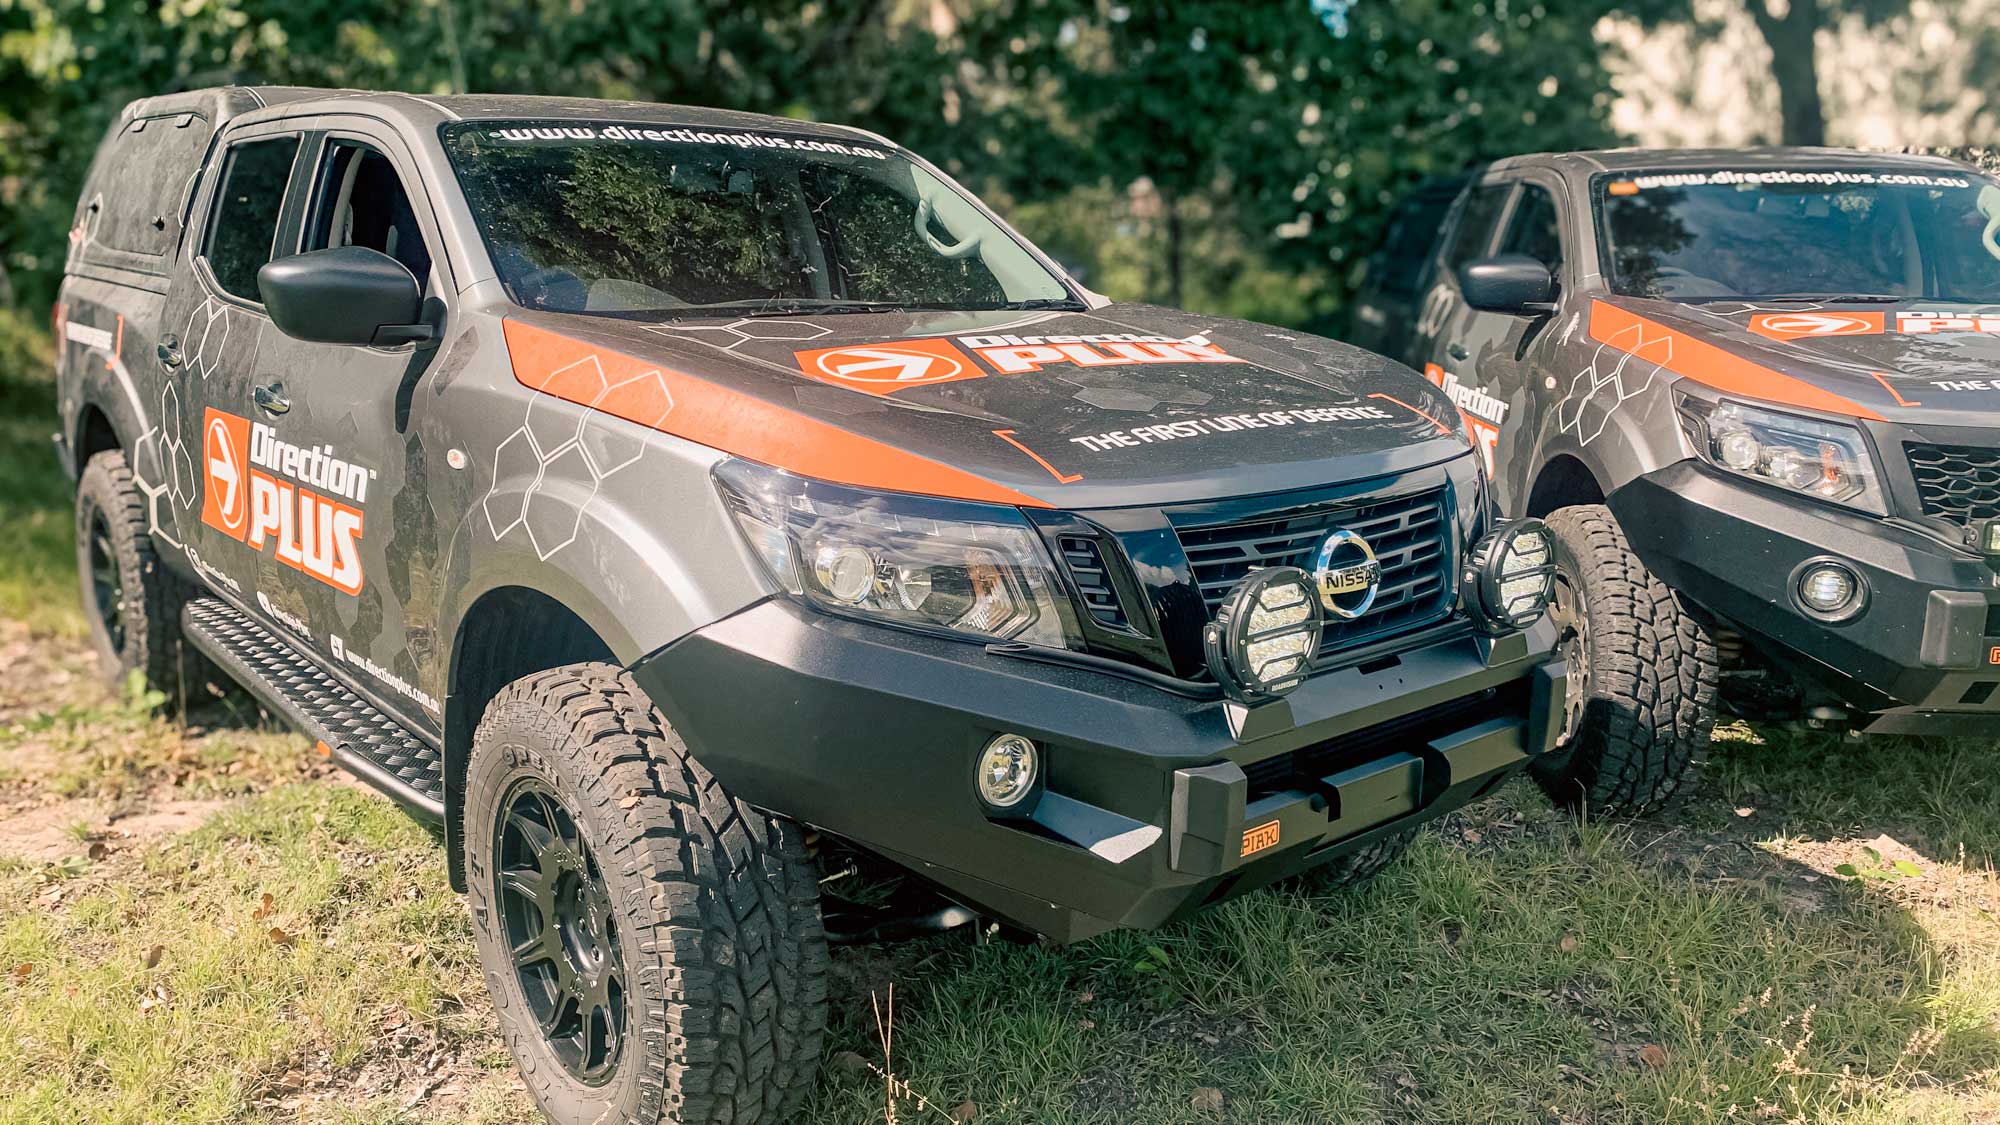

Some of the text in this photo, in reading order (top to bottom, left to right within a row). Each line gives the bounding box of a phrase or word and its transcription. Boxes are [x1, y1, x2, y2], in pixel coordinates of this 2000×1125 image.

[500, 126, 887, 160] www.directionplus.com.au
[1635, 170, 1969, 189] www.directionplus.com.au
[956, 333, 1212, 349] Direction
[983, 344, 1250, 372] PLUS
[1930, 380, 1992, 391] THE
[1069, 406, 1394, 452] THE FIRST LINE OF DEFENCE
[250, 421, 369, 504] Direction
[249, 473, 363, 590] PLUS
